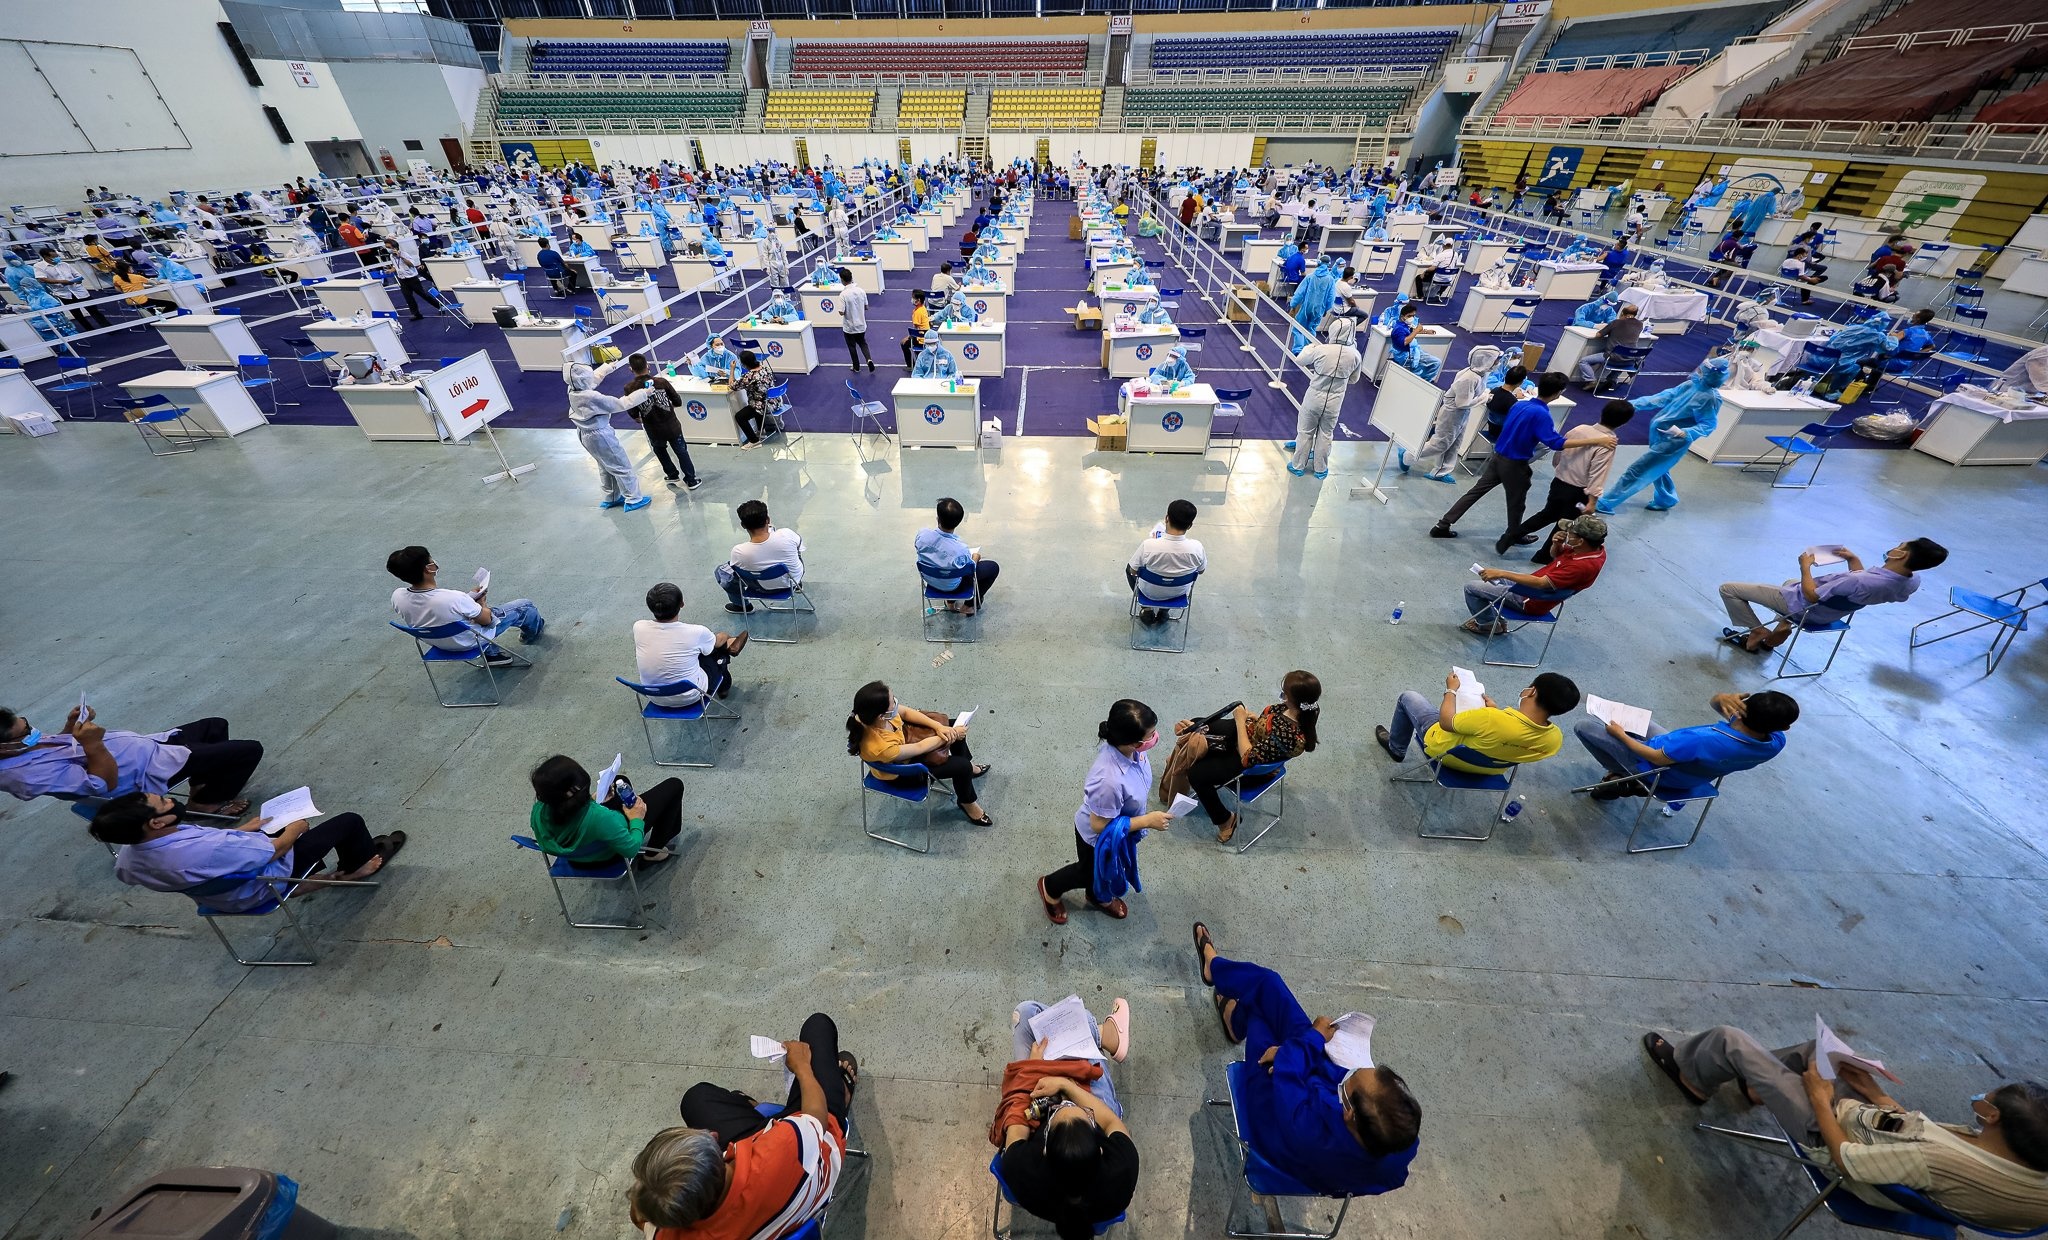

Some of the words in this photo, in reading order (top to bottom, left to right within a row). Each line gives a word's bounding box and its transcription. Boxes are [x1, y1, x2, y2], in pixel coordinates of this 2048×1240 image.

[1515, 3, 1540, 14] EXIT
[1113, 17, 1131, 26] EXIT
[1301, 16, 1311, 24] C1
[622, 25, 633, 33] C2
[751, 21, 769, 30] EXIT
[291, 62, 306, 71] EXIT
[448, 381, 464, 398] LỐI
[462, 376, 479, 391] VÀO
